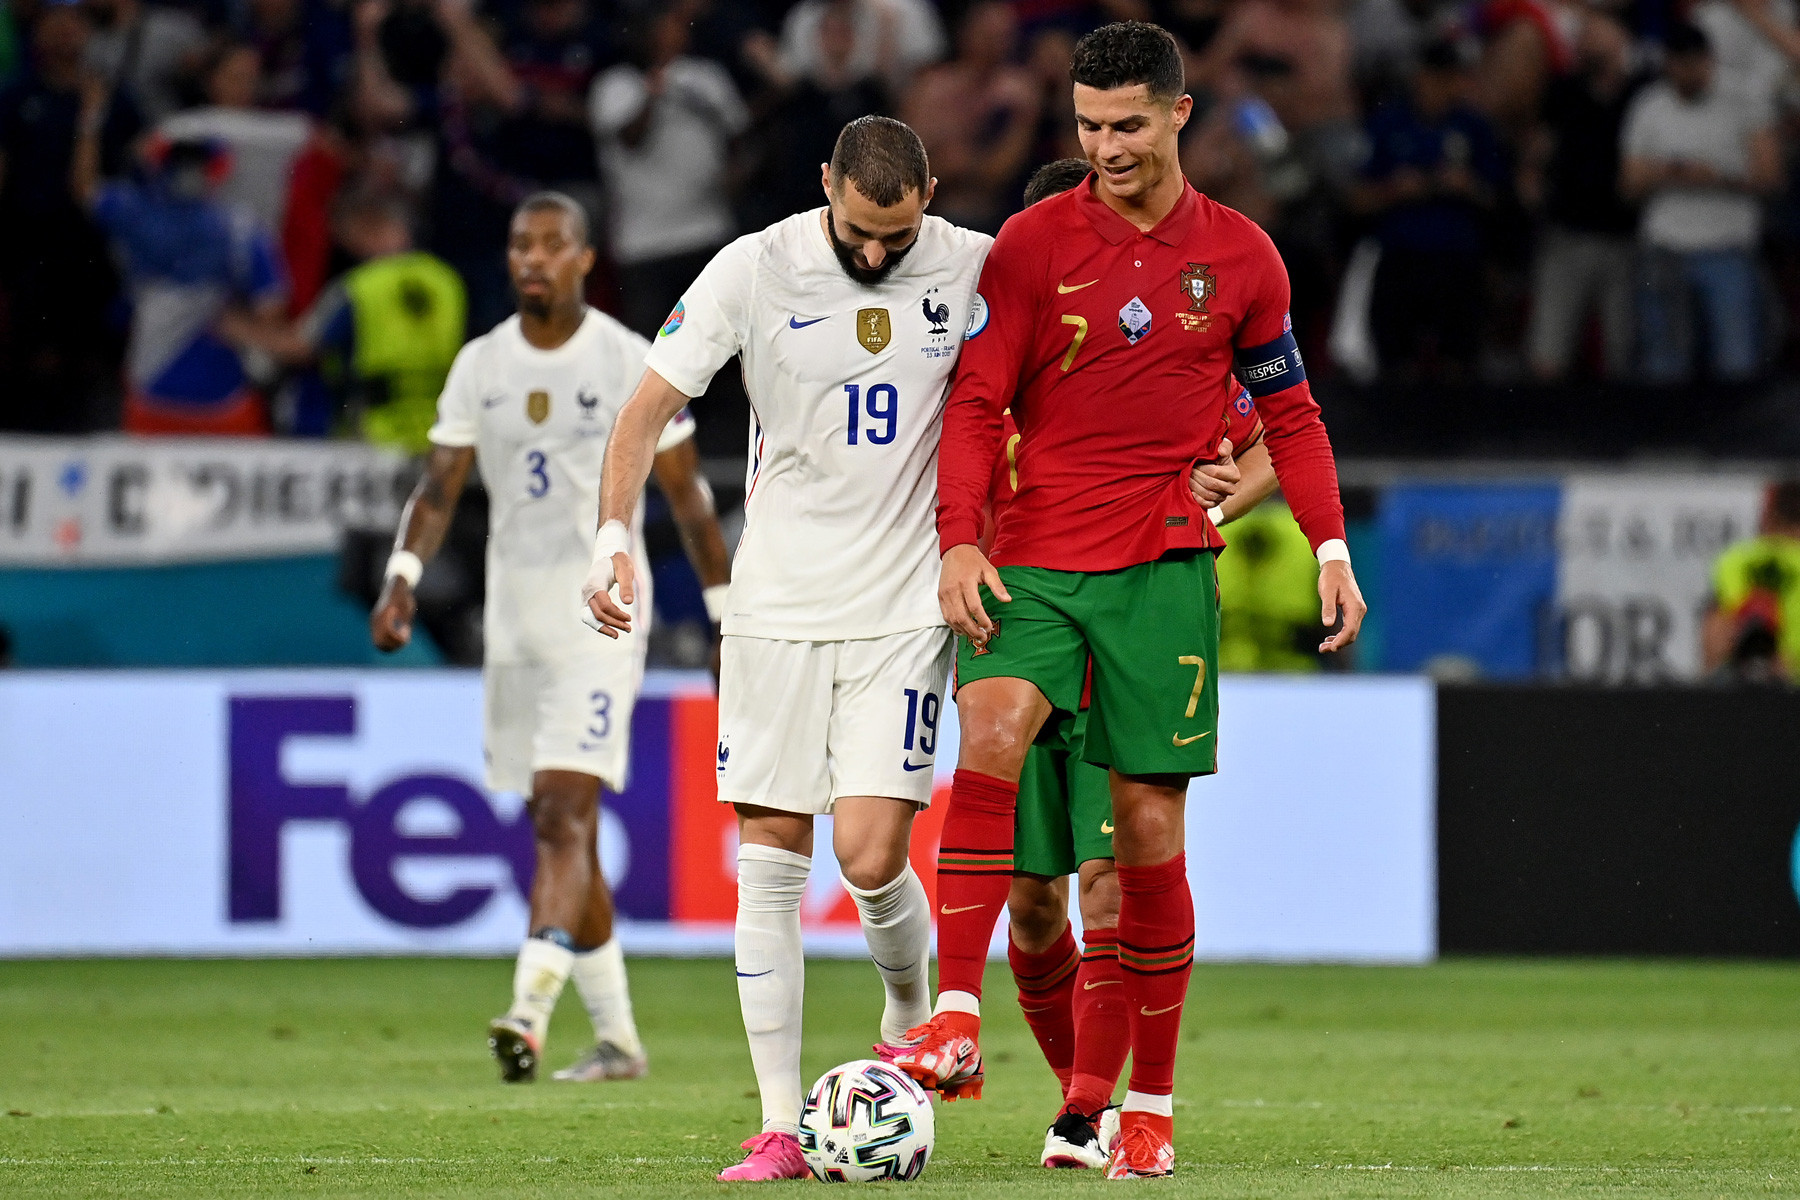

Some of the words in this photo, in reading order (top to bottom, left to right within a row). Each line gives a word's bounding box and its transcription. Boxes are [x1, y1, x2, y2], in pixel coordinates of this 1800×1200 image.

[1060, 314, 1088, 372] 7
[1248, 359, 1287, 380] RESPECT
[844, 383, 898, 445] 19
[526, 450, 549, 499] 3
[588, 690, 612, 740] 3
[1178, 655, 1206, 718] 7
[903, 688, 939, 756] 19
